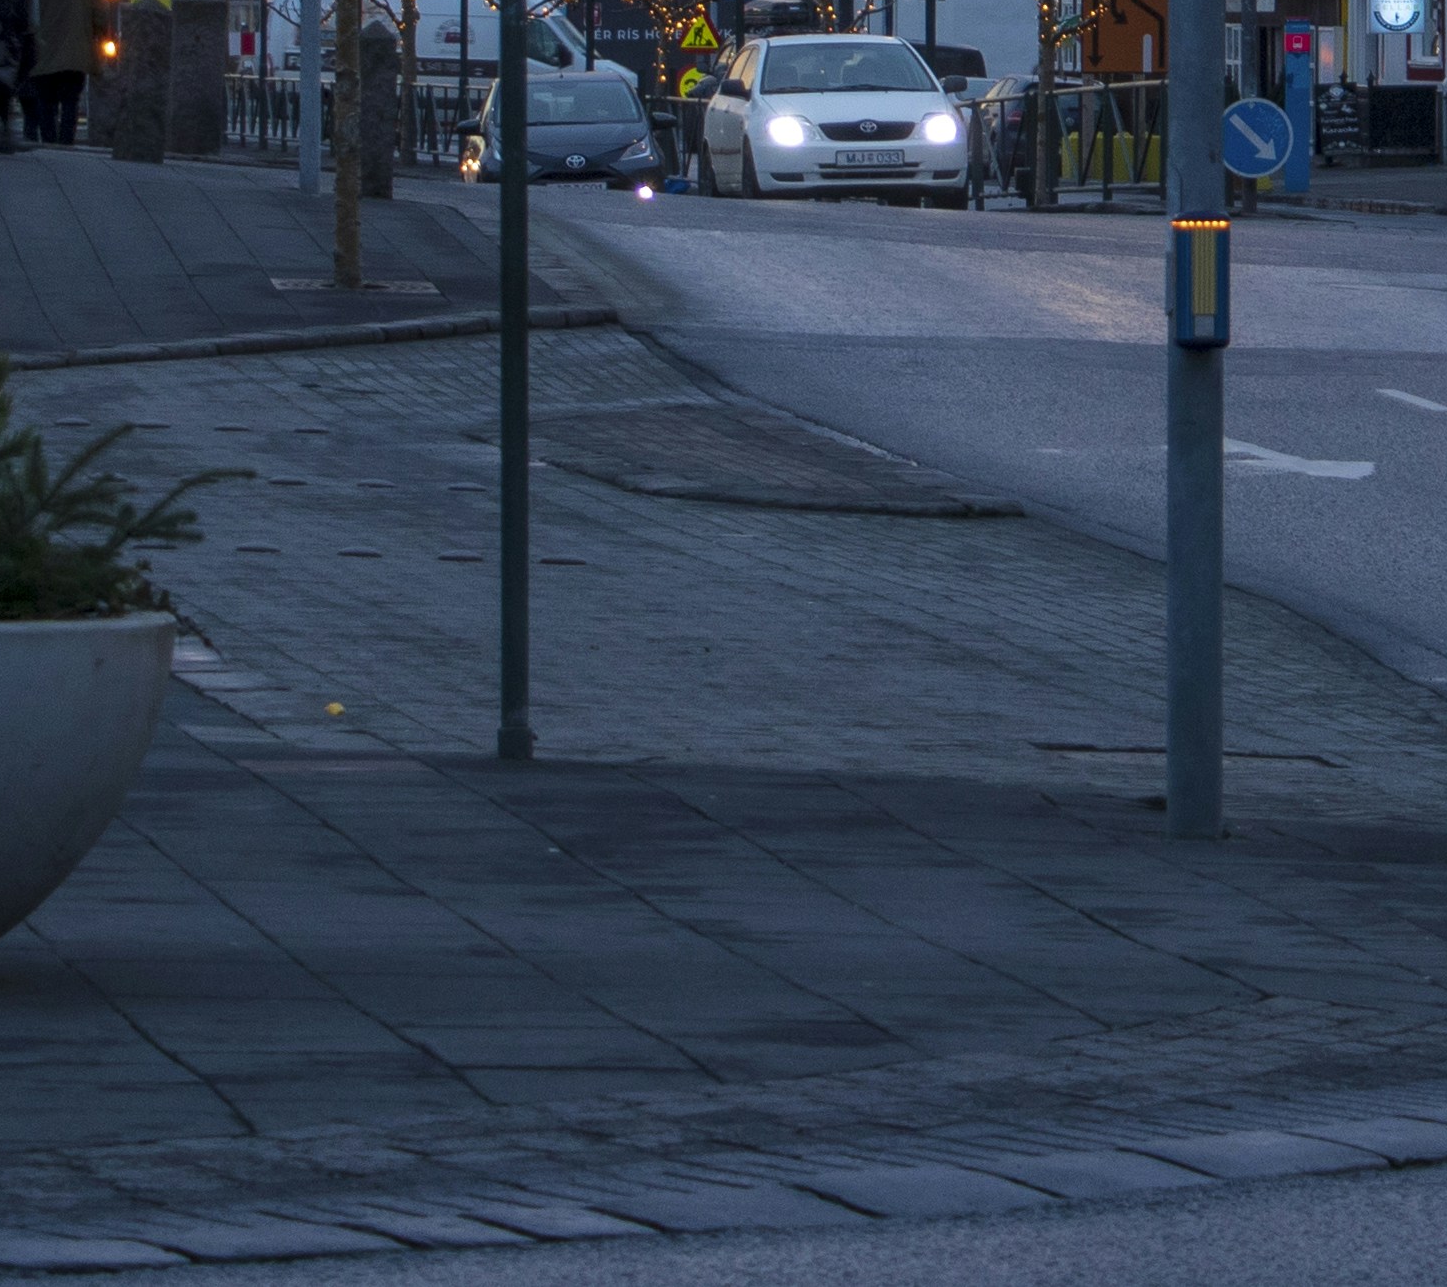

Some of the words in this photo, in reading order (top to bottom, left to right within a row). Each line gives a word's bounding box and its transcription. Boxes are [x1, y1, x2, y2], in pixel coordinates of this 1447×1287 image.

[617, 27, 640, 40] RÍS
[846, 153, 866, 164] MJ
[876, 152, 901, 163] 033
